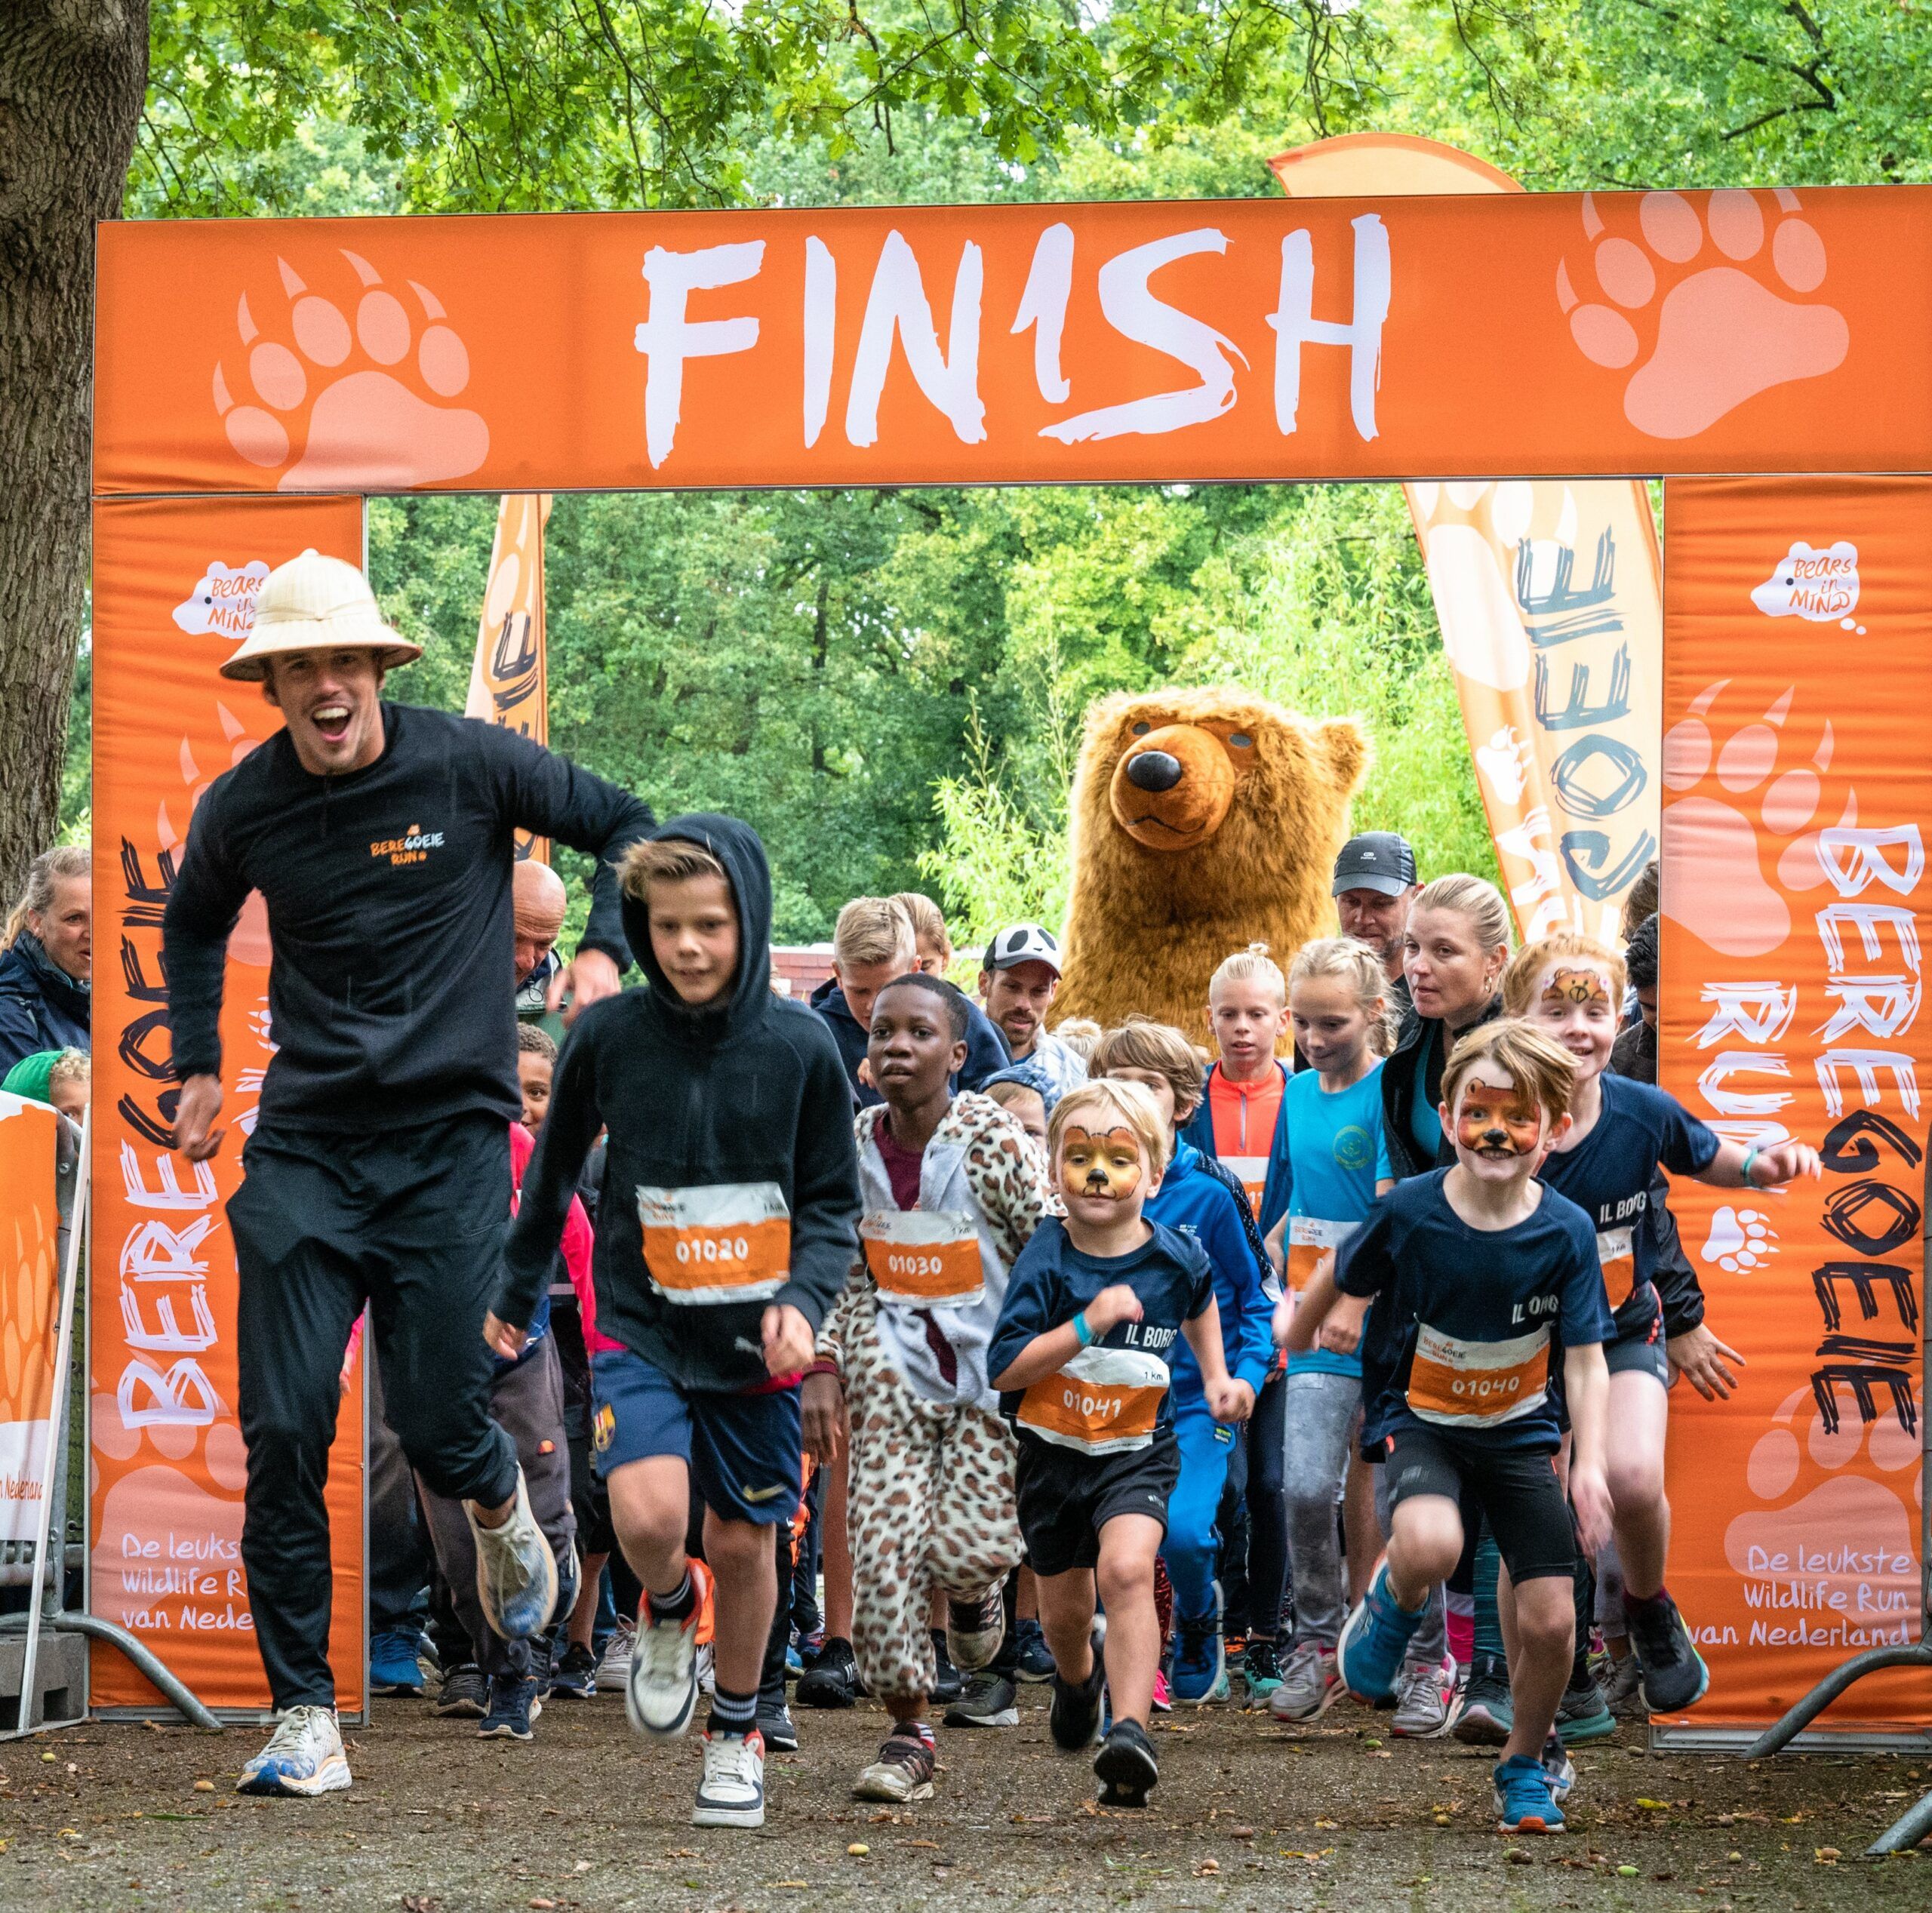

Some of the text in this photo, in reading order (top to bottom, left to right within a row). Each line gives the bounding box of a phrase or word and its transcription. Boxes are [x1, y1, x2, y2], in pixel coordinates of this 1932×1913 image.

[634, 214, 1391, 469] FINISH
[1821, 579, 1841, 594] in
[1789, 587, 1850, 614] MIND
[370, 832, 445, 857] BEREGOEIE
[391, 850, 417, 866] RUN
[1810, 823, 1925, 1439] BEREGOEIE
[1600, 1204, 1613, 1224] IL
[675, 1236, 749, 1265] 01020
[888, 1254, 943, 1276] 01030
[1512, 1304, 1526, 1324] IL
[1124, 1324, 1140, 1345] IL
[1451, 1376, 1520, 1396] 01040
[1063, 1389, 1121, 1419] 01041
[122, 1531, 242, 1560] De leuks
[1748, 1544, 1911, 1574] De leukste
[122, 1567, 219, 1595] Wildlife
[1744, 1580, 1909, 1613] Wildlife Run
[122, 1610, 171, 1629] van
[1686, 1617, 1910, 1647] van Nederland
